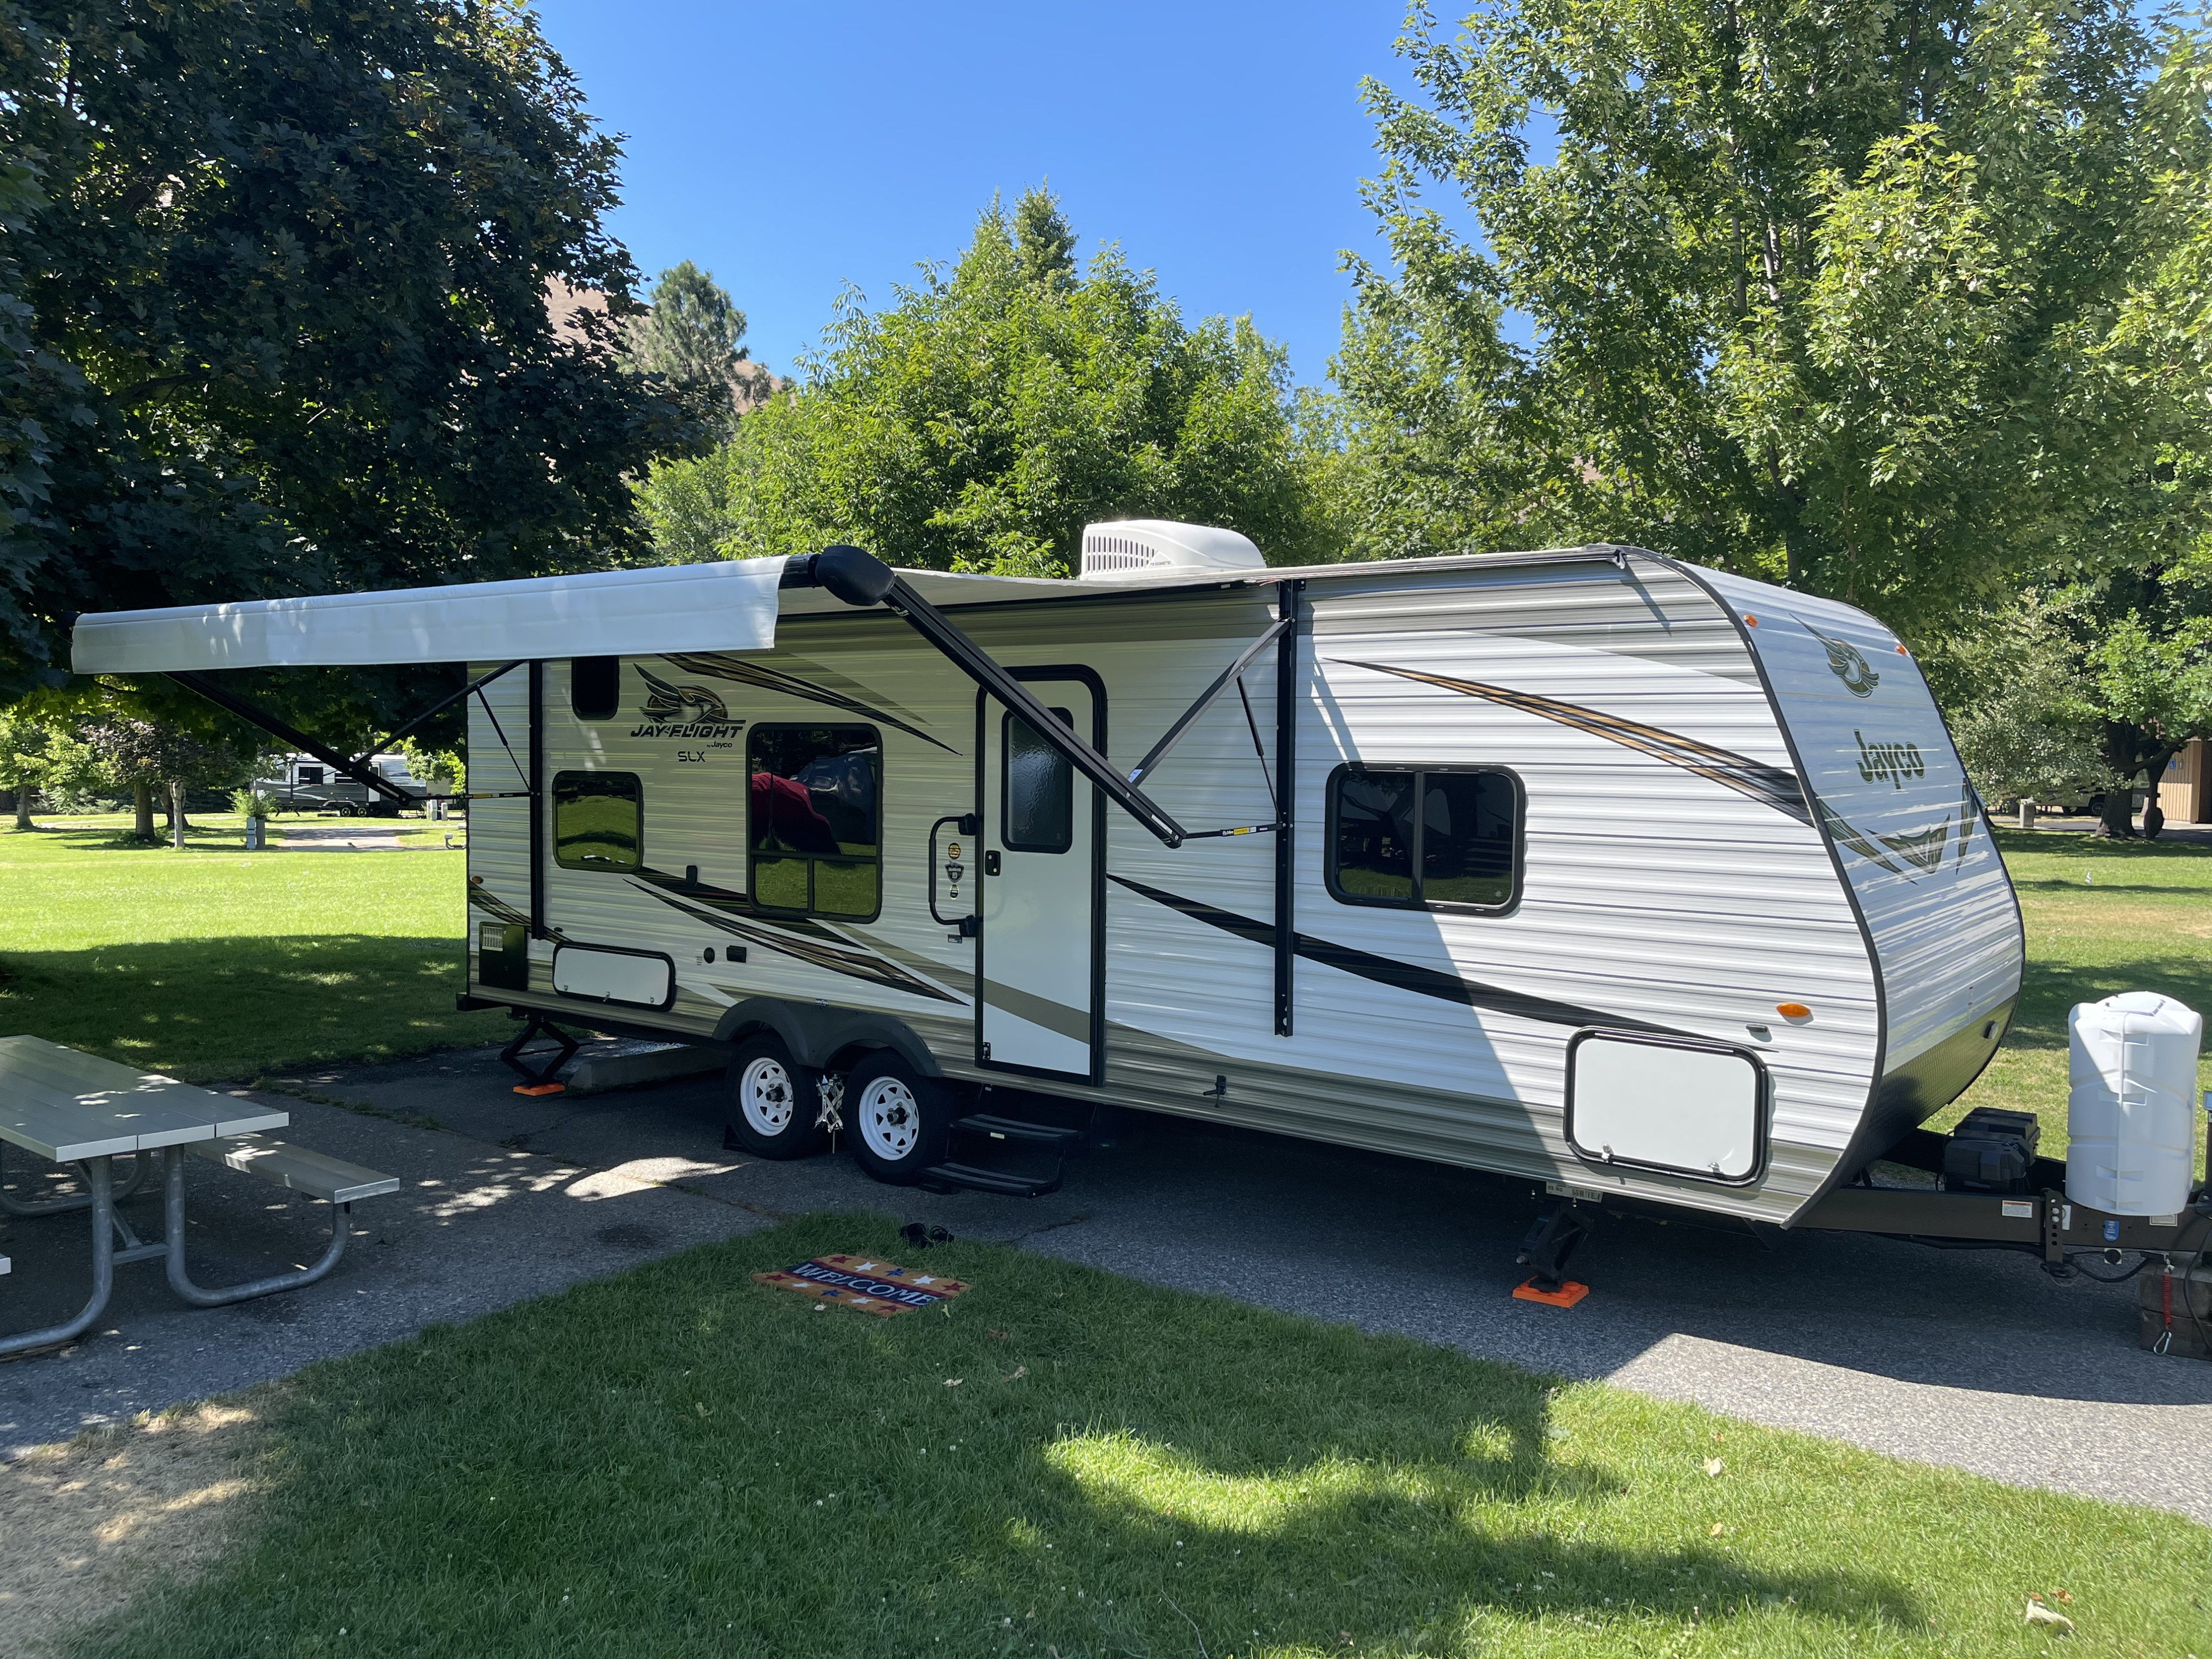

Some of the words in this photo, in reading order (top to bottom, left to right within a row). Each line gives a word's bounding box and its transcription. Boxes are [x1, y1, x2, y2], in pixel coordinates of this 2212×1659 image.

[677, 751, 706, 762] SLX
[1854, 729, 1924, 791] Jayco
[792, 1263, 940, 1306] WELCOME
